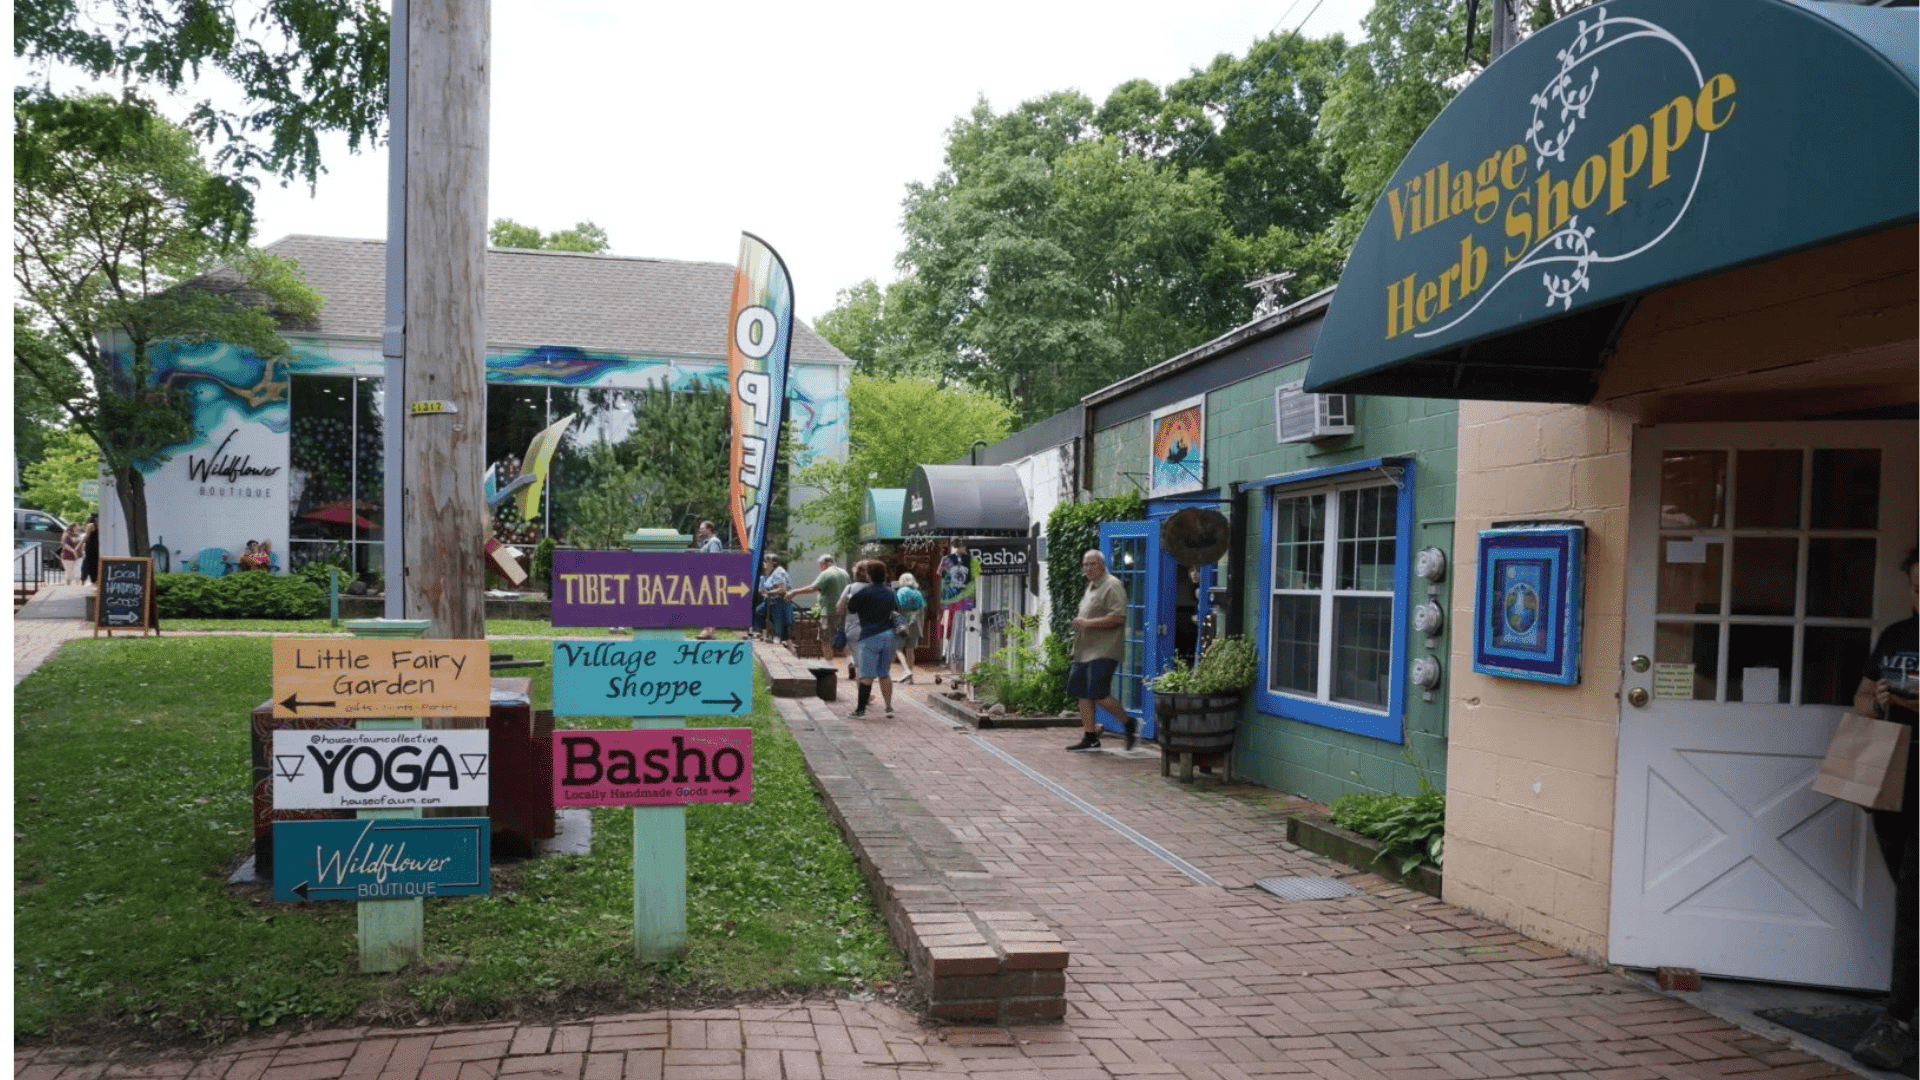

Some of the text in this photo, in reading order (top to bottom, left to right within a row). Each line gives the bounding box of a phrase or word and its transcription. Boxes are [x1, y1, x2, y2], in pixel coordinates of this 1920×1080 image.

[1385, 73, 1736, 340] Herb Shoppe
[1387, 144, 1528, 242] Village
[189, 428, 281, 483] Wildflower
[200, 486, 271, 498] BOUTIQUE
[969, 547, 1027, 565] Basho
[107, 564, 141, 581] Local
[560, 573, 729, 605] TIBET BAZAAR
[296, 648, 467, 680] Little Fairy
[557, 641, 745, 675] Village Herb
[333, 672, 435, 695] Garden
[606, 673, 702, 705] Shoppe
[310, 734, 438, 745] @houseofaumcollective
[306, 744, 459, 794] YOGA
[561, 736, 745, 787] Basho
[340, 795, 441, 806] houseofaum.com
[564, 787, 708, 801] Locally Handmade Goods
[316, 820, 451, 886] Wildflower
[357, 882, 437, 897] BOUTIQUE
